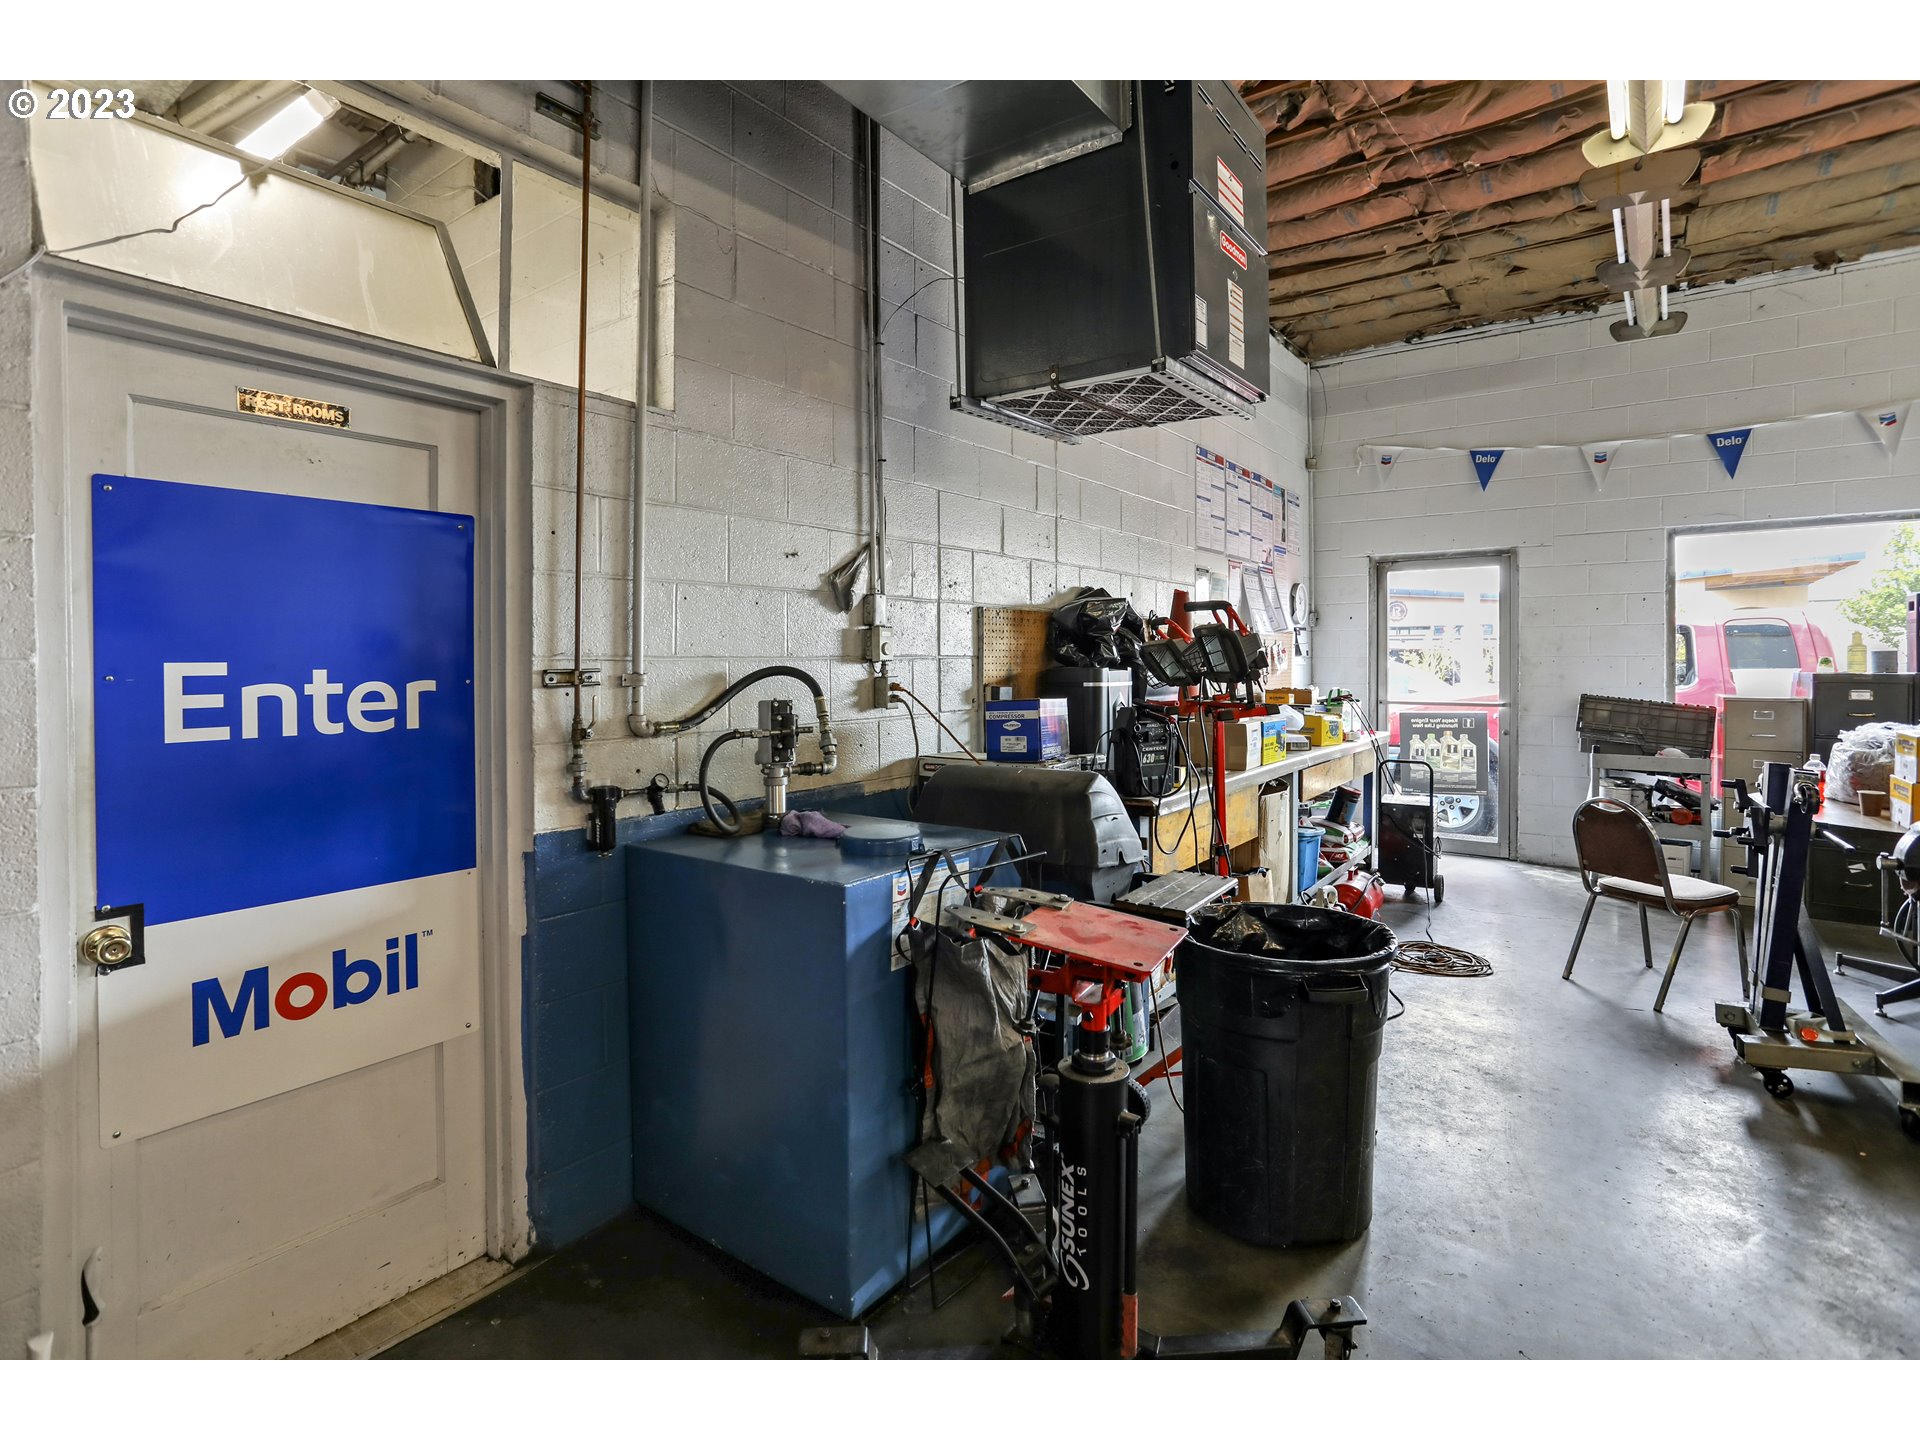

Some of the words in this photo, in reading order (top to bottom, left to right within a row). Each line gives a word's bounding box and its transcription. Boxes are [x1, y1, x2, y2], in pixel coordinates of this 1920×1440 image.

[1221, 235, 1246, 264] Goodman
[245, 395, 286, 412] REST
[293, 405, 344, 421] ROOMS
[1475, 453, 1497, 464] Delo
[1716, 435, 1743, 447] Delo
[163, 661, 438, 744] Enter
[192, 933, 420, 1048] Mobil
[1061, 1159, 1075, 1255] SUNEX
[1077, 1166, 1087, 1256] TOOLS
